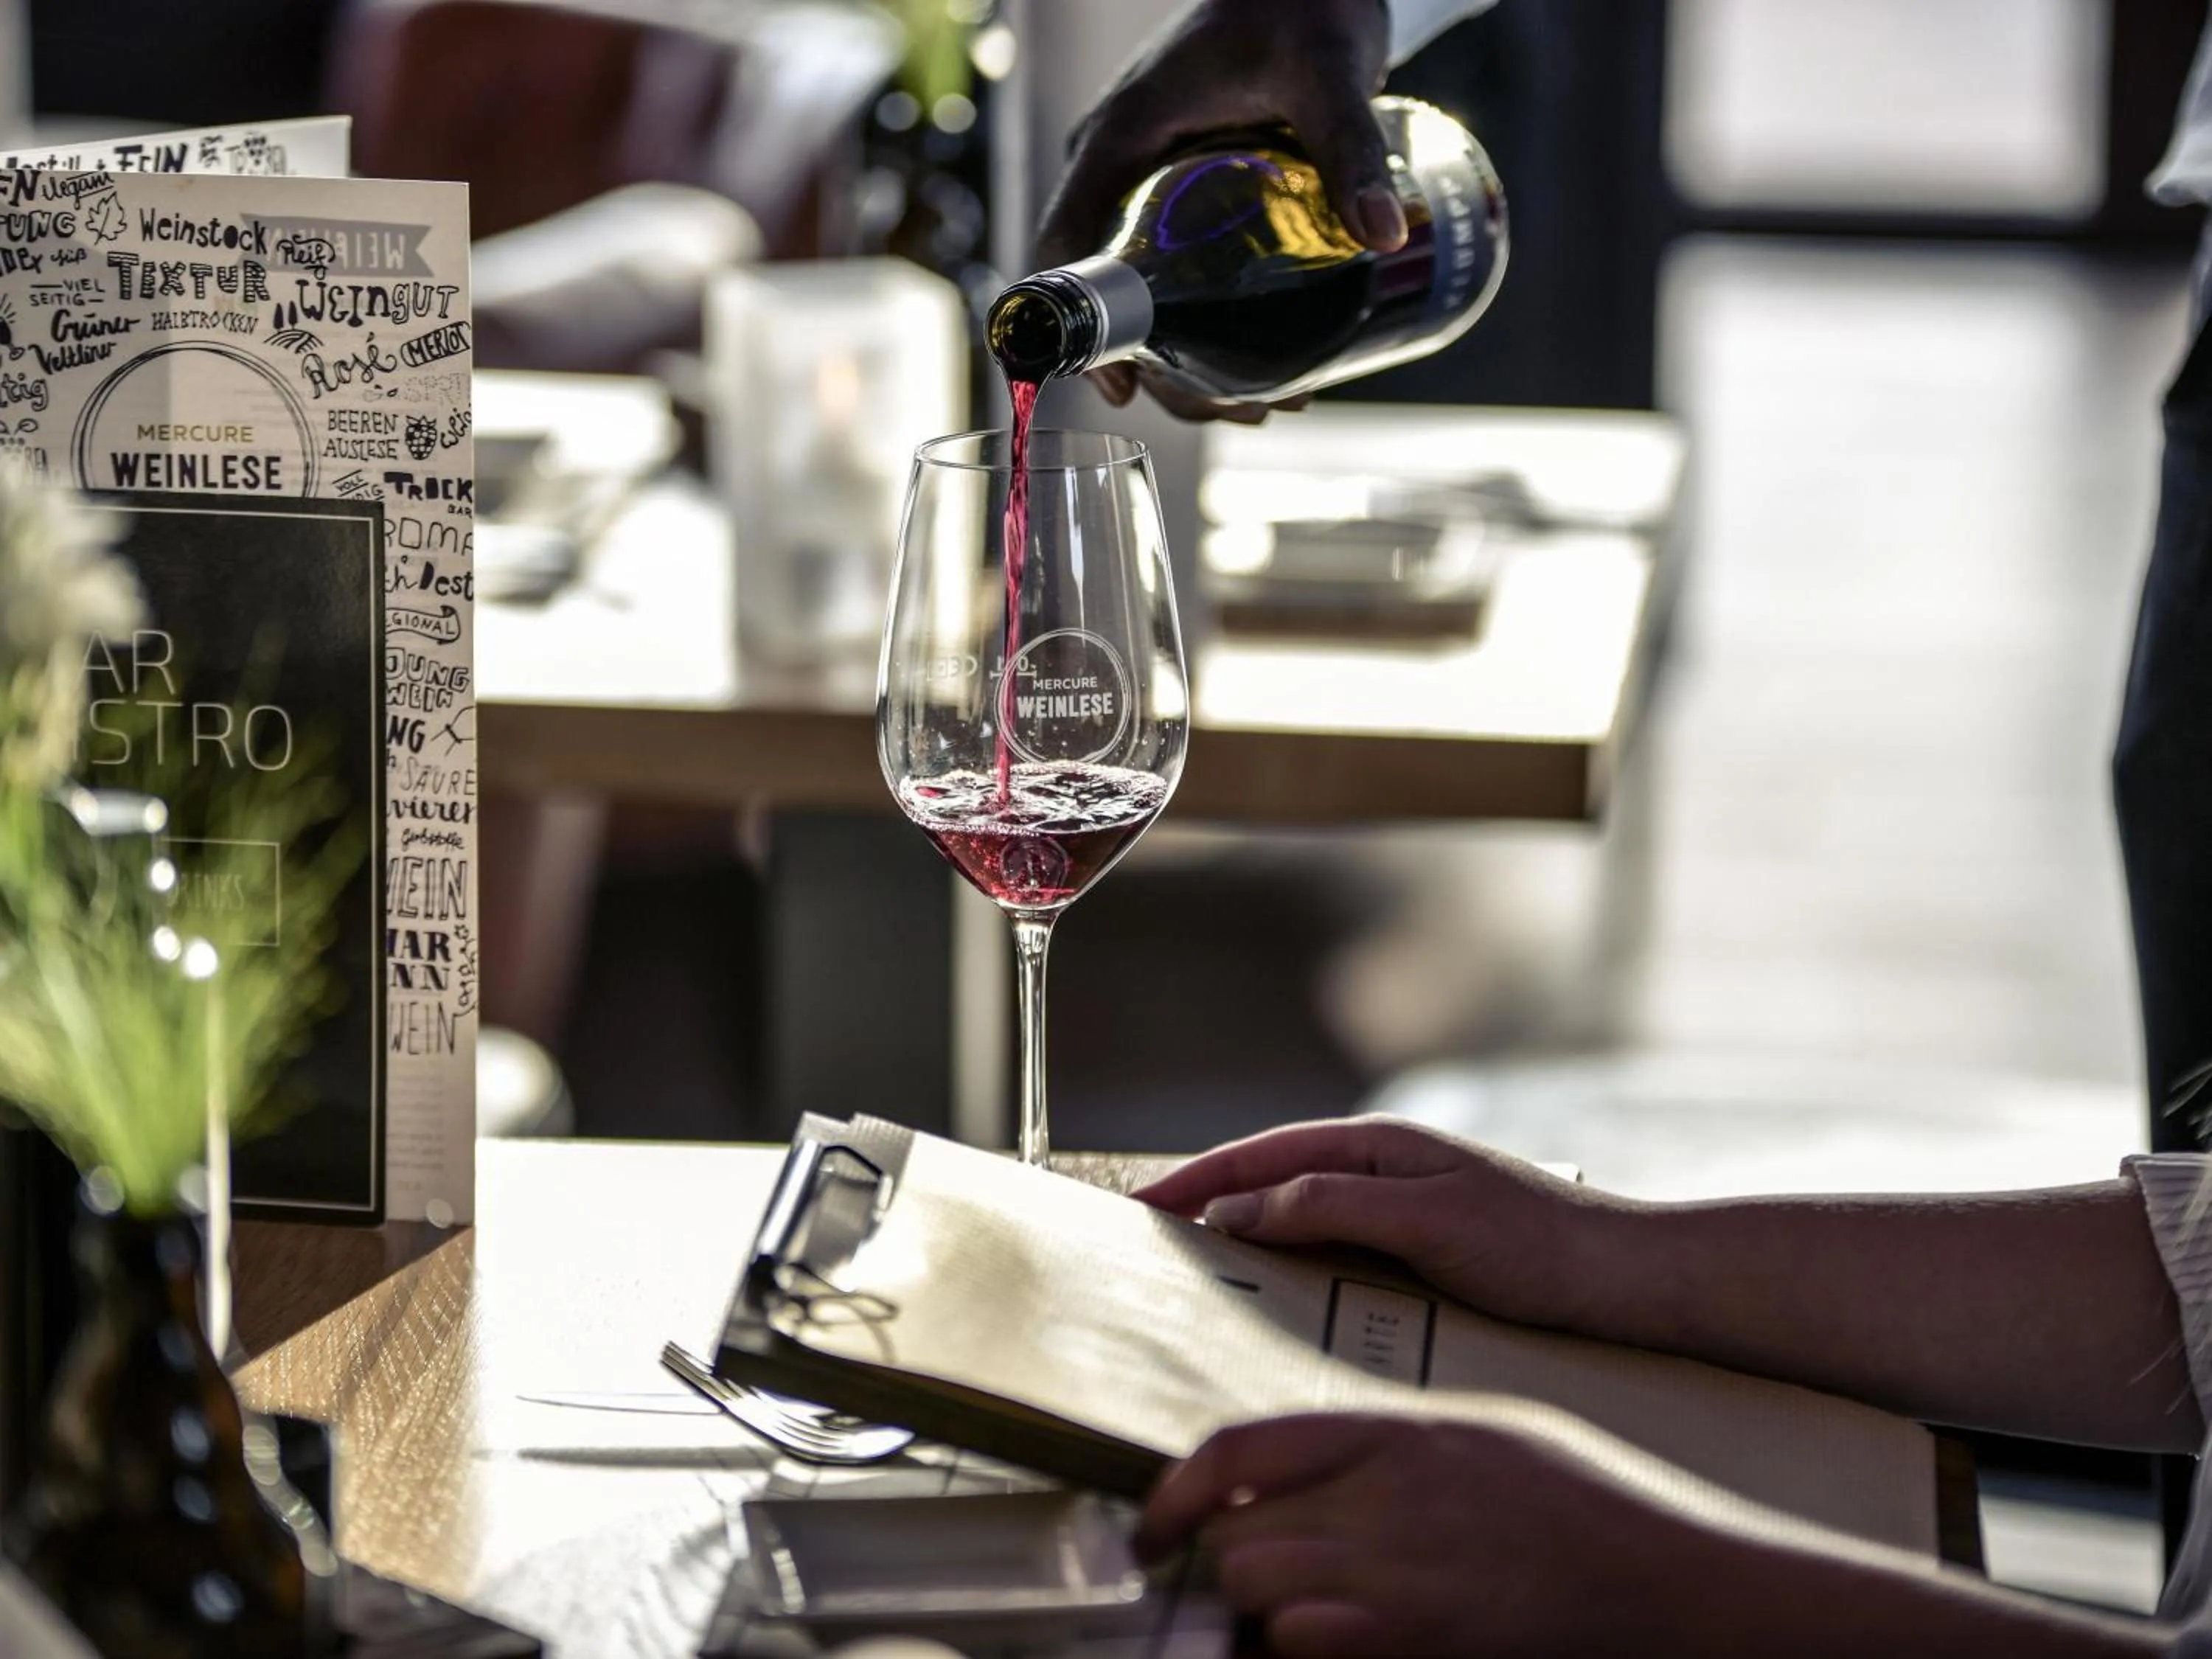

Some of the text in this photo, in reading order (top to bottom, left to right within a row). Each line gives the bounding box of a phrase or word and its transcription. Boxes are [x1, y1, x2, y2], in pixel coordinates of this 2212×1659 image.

[0, 210, 76, 243] UNG
[139, 207, 268, 254] Weinstock
[63, 279, 105, 293] VIEL
[107, 251, 271, 303] TEXTUR
[29, 293, 86, 307] SEITIG
[50, 309, 141, 343] Grüner
[151, 310, 260, 333] HALBTROCKEN
[0, 372, 49, 412] tig
[136, 424, 254, 443] MERCURE
[327, 409, 399, 434] BEEREN
[323, 439, 400, 462] AUSLESE
[111, 452, 282, 490] WEINLESE
[1032, 676, 1098, 691] MERCURE
[1016, 693, 1115, 718] WEINLESE
